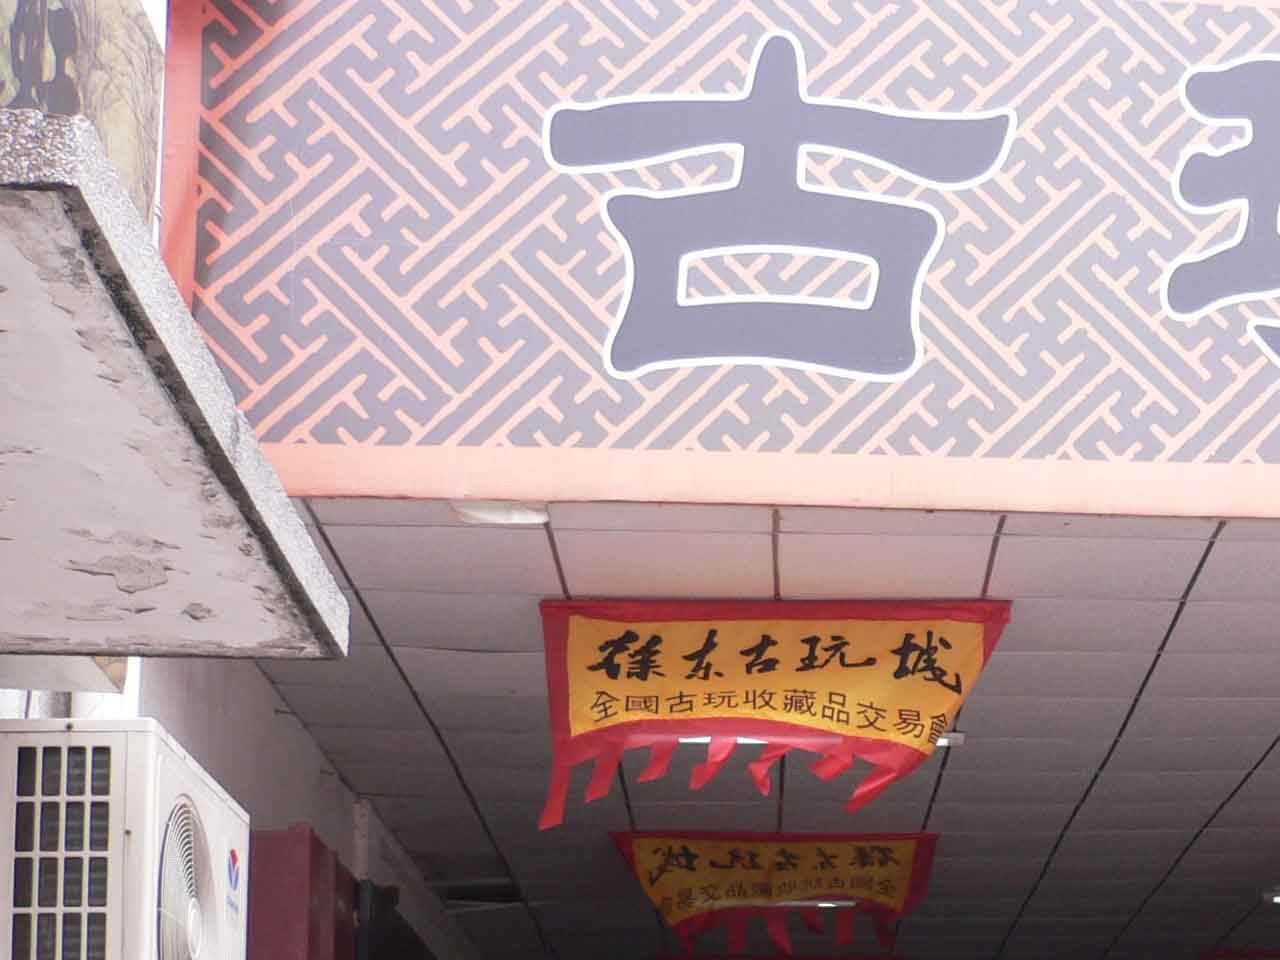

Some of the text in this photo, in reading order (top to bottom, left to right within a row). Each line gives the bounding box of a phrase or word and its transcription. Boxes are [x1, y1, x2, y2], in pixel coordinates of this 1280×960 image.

[590, 689, 948, 744] 全國古玩收藏品交易會
